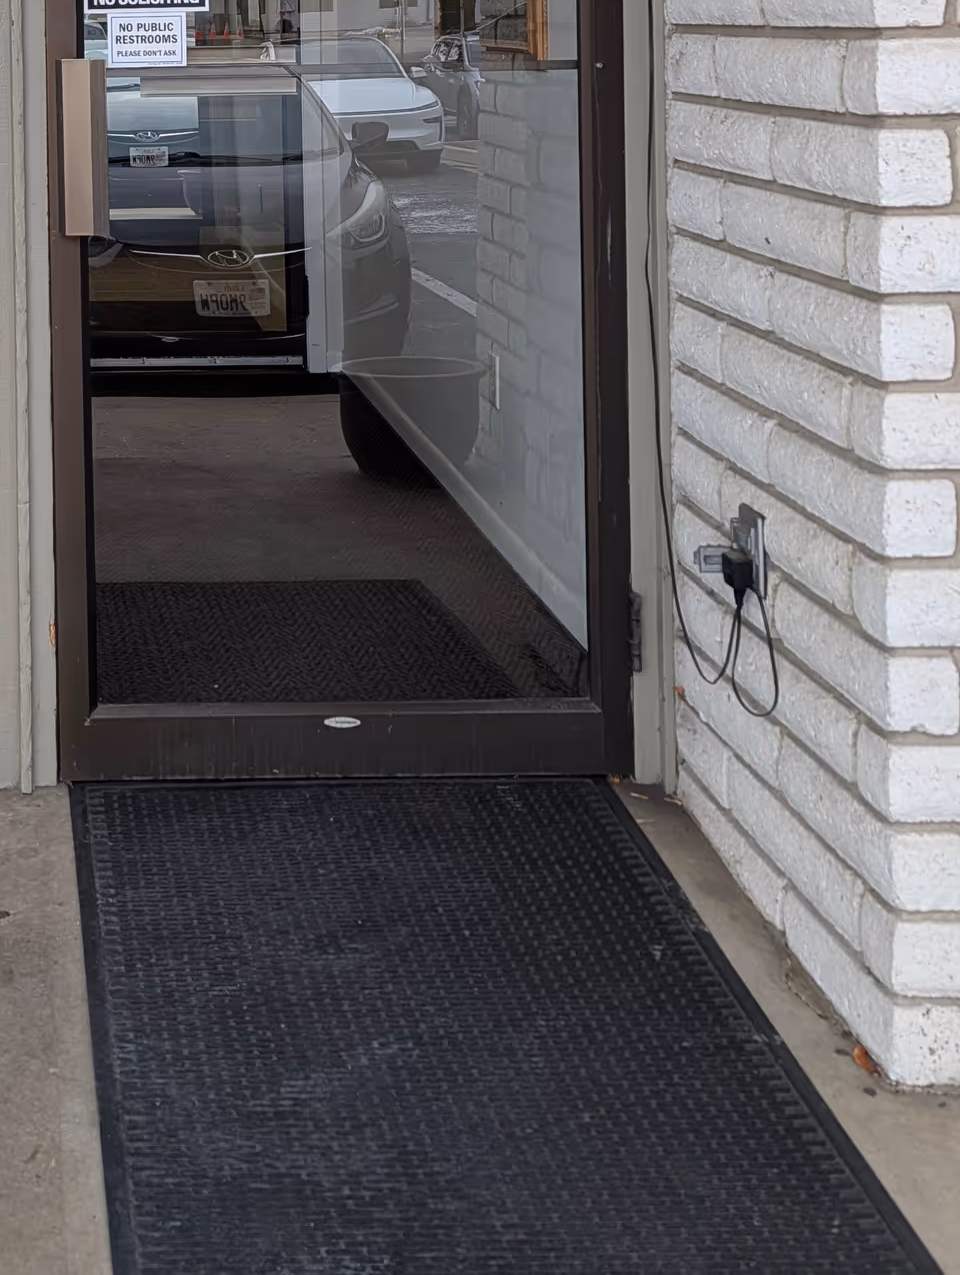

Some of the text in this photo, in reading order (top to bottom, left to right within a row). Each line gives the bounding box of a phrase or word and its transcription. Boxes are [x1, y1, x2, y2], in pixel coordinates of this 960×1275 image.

[118, 22, 175, 33] NO PUBLIC
[115, 34, 178, 45] RESTROOMS
[116, 50, 142, 58] PLEASE
